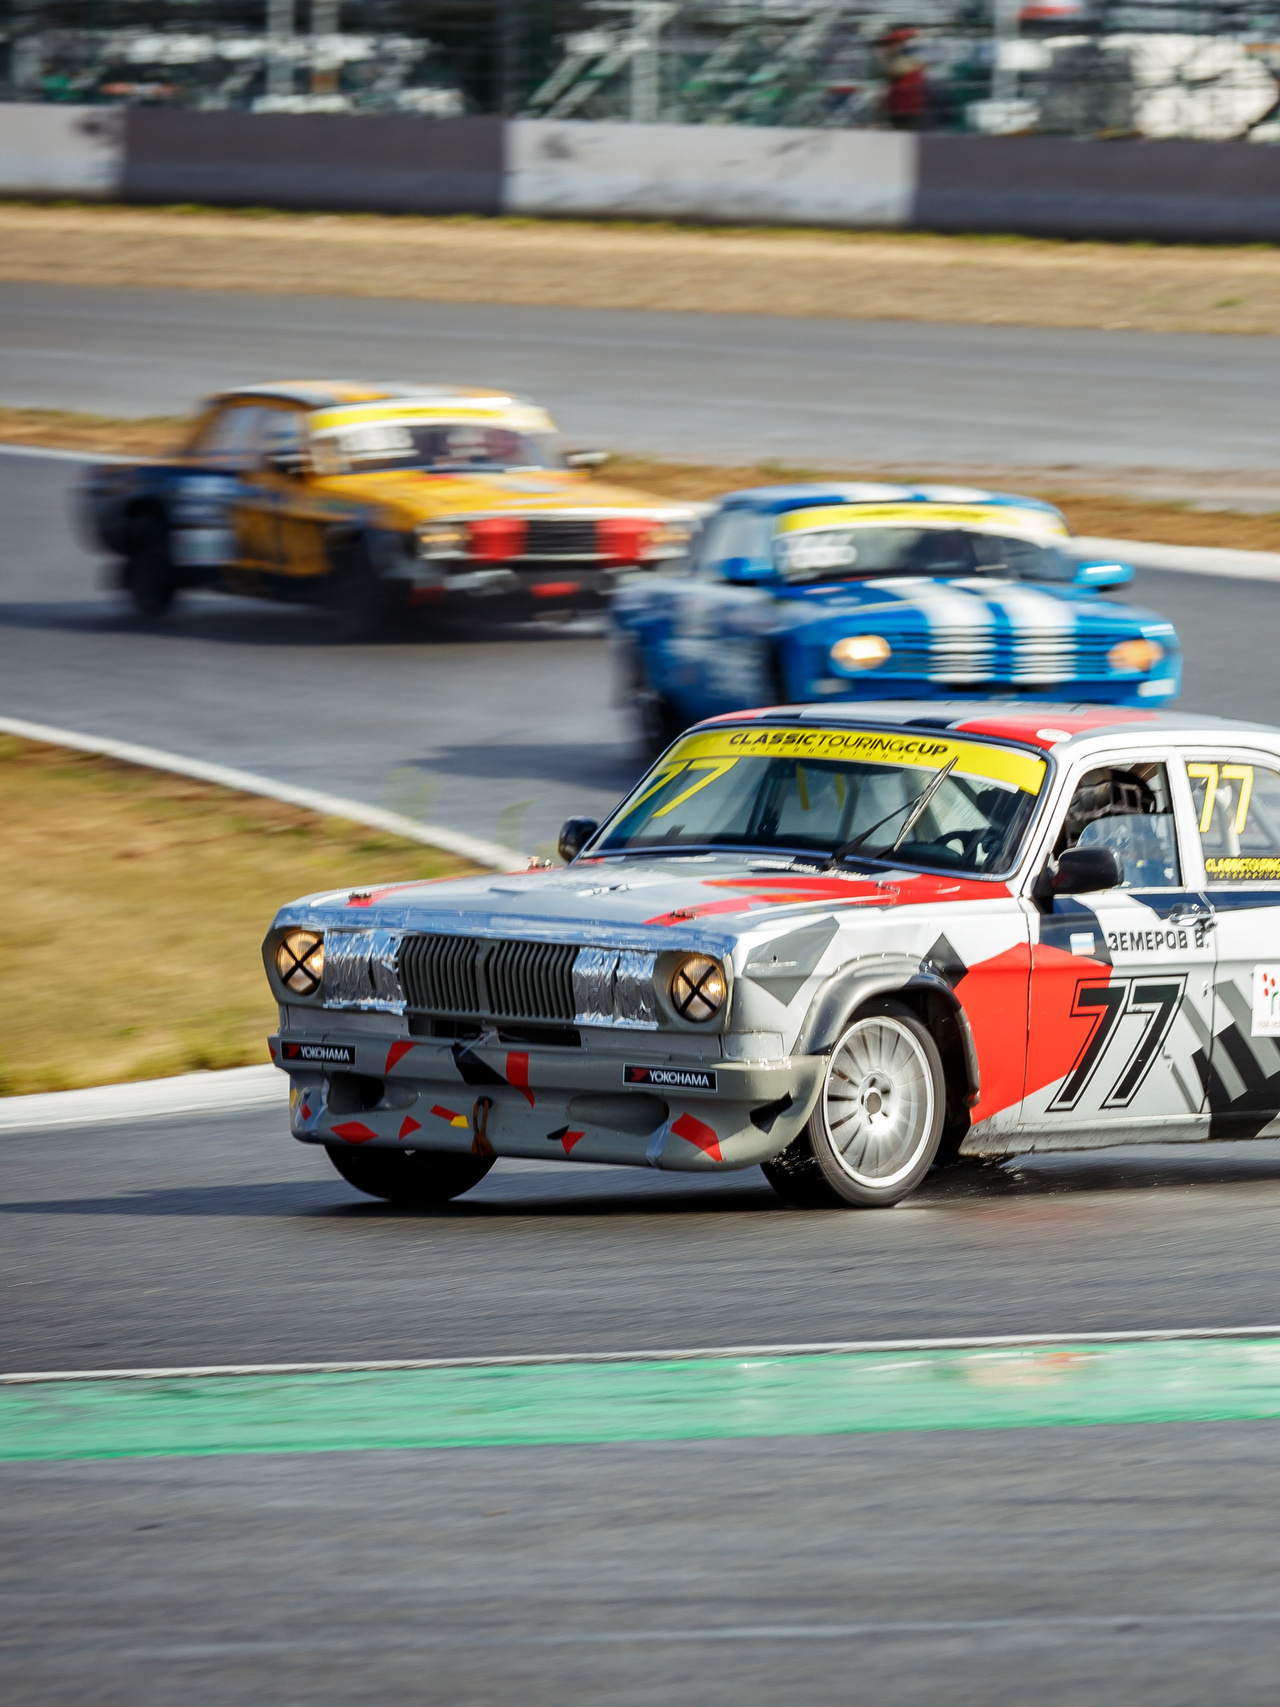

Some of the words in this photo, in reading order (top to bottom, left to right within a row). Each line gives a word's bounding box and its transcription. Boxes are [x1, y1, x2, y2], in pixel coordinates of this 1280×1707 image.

[729, 732, 949, 756] CLASSICTOURINGCUP
[609, 756, 741, 828] 77
[1187, 763, 1254, 834] 77
[1108, 930, 1188, 951] ЗЕМЕРОВ
[301, 1045, 350, 1061] YOKOHAMA
[1044, 972, 1190, 1113] 77
[649, 1069, 710, 1087] YOKOHAMA
